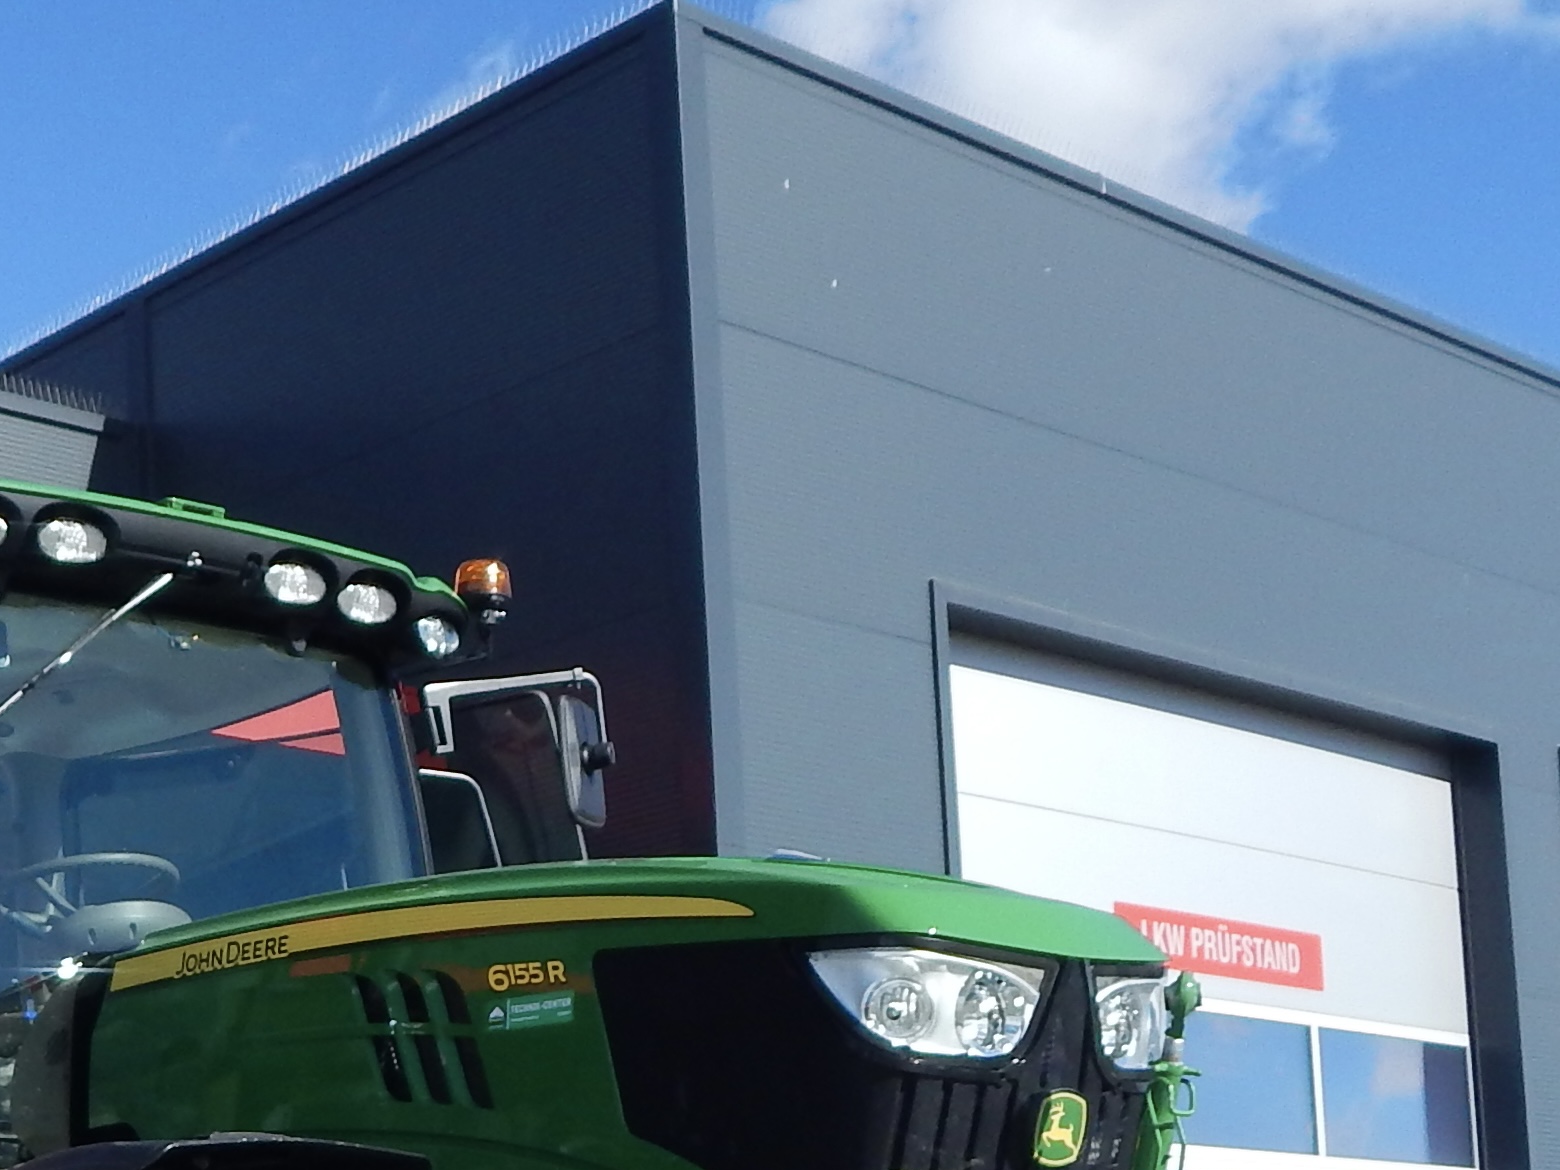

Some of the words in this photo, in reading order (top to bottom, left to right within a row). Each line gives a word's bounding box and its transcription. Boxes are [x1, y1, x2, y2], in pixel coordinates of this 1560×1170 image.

[175, 951, 223, 976] JOHN
[226, 935, 289, 965] DEERE
[1191, 923, 1301, 974] PRÜFSTAND
